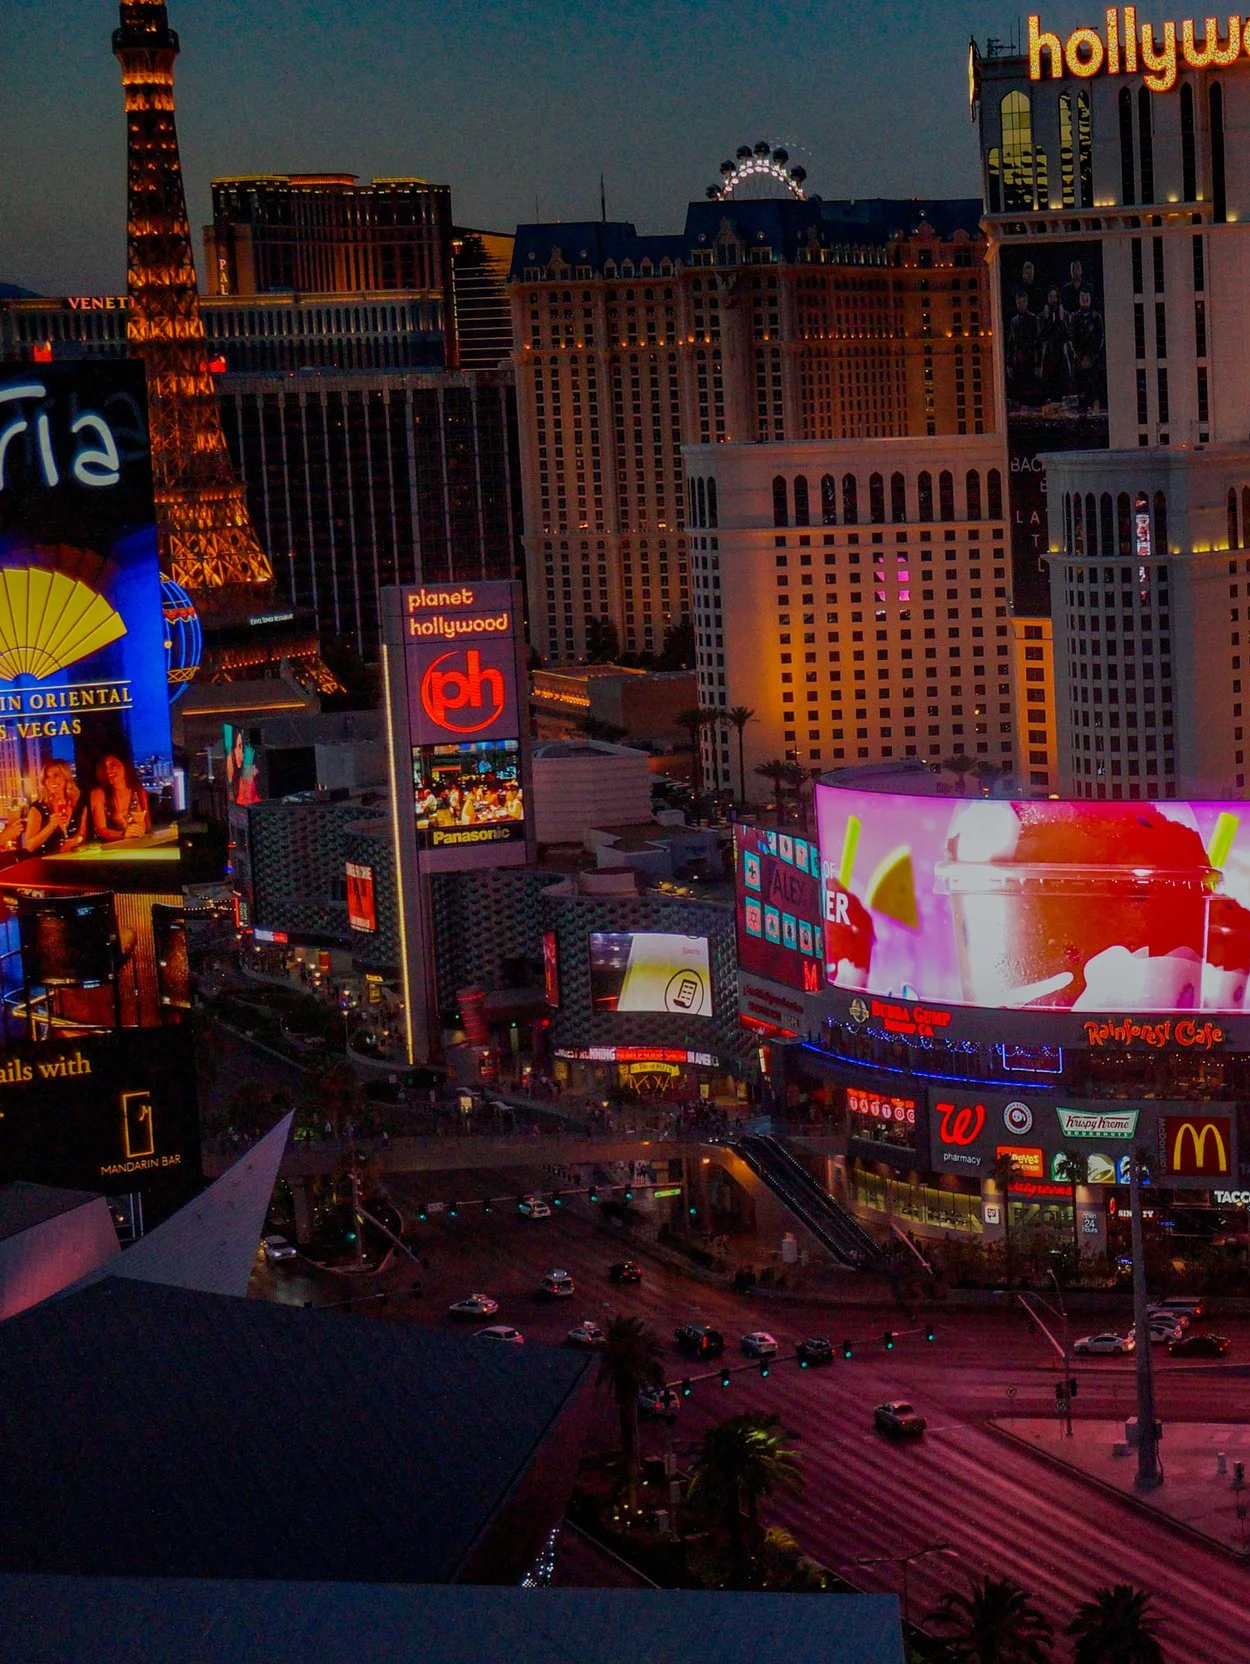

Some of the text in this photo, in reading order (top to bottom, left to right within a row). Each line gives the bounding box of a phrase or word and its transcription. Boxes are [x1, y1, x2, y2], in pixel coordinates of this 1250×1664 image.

[408, 588, 474, 612] planet
[409, 613, 510, 638] hollywood
[429, 648, 506, 724] ph
[29, 687, 133, 709] ORIENTAL
[16, 719, 82, 738] VEGAS
[433, 826, 511, 846] Panasonic
[912, 1006, 952, 1027] GUMP
[1084, 1018, 1225, 1049] Rainforest Cafe
[38, 1052, 92, 1079] with
[1065, 1114, 1131, 1130] Krispy Kreme
[100, 1154, 182, 1175] MANDARIN BAR
[943, 1152, 982, 1166] pharmacy
[1084, 1219, 1096, 1228] 24
